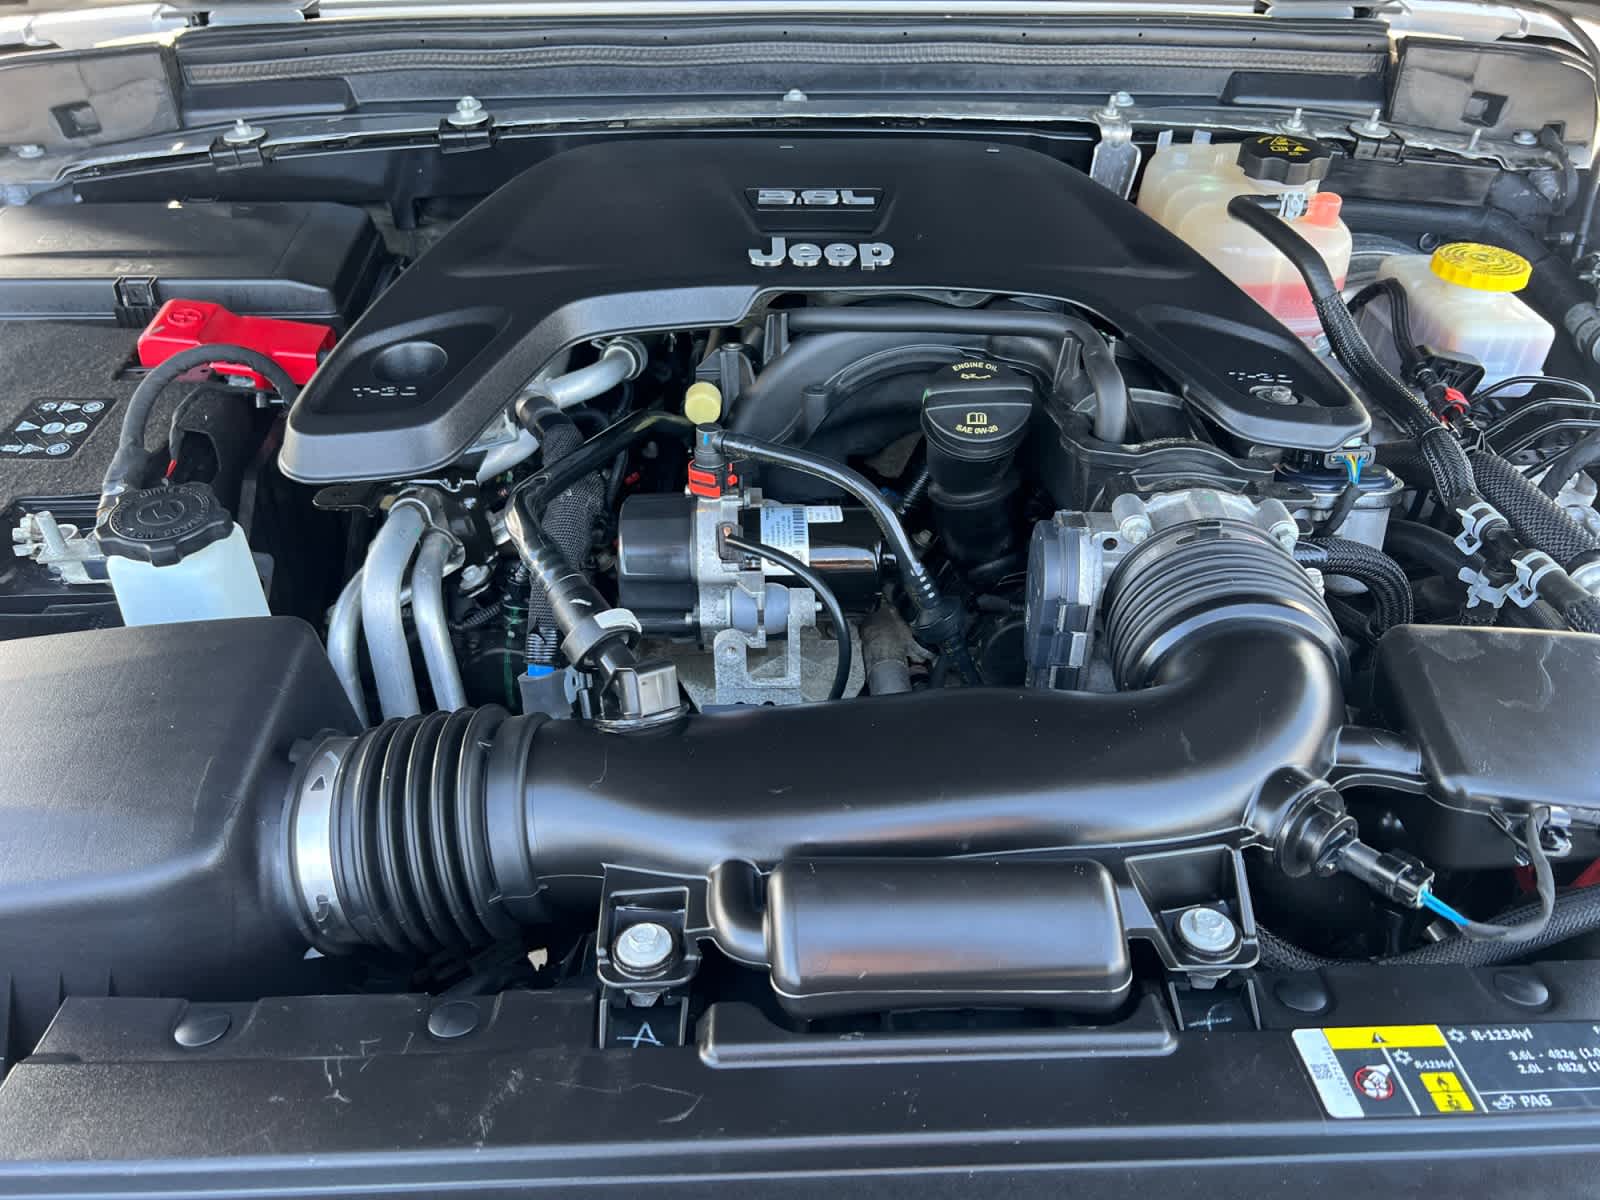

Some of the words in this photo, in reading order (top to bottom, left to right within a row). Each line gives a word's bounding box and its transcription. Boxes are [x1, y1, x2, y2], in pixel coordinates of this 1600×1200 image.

[748, 236, 895, 271] Jeep
[952, 361, 984, 372] ENGINE
[985, 363, 998, 372] OIL
[955, 424, 973, 434] SAE
[1470, 1026, 1534, 1042] R-1234yf
[1508, 1049, 1535, 1061] 3.6L
[1548, 1048, 1578, 1060] 482g
[1517, 1063, 1544, 1074] 2.0L
[1557, 1062, 1587, 1074] 482g
[1519, 1094, 1553, 1108] PAG
